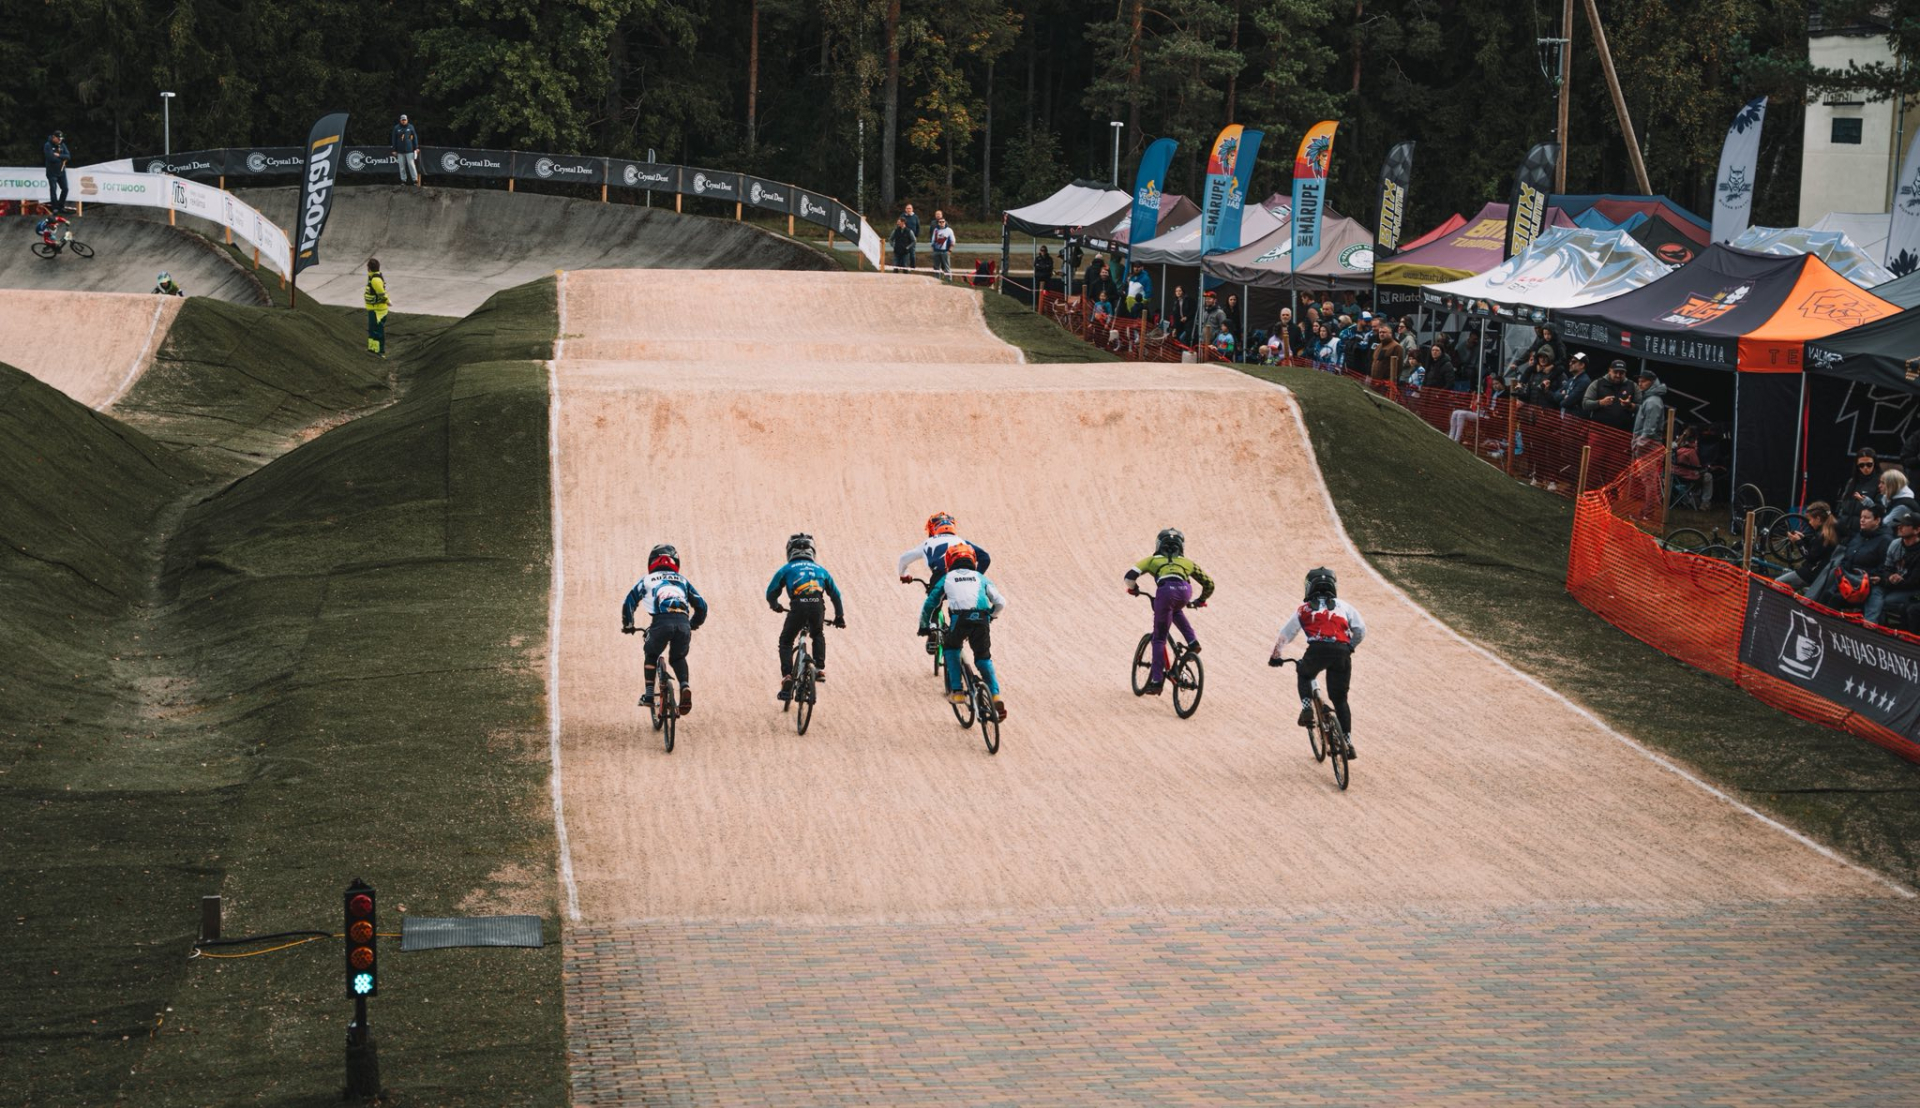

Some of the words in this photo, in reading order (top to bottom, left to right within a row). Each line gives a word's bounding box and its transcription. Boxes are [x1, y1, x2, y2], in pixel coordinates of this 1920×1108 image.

[167, 163, 192, 173] Crystal
[192, 161, 211, 169] Dent
[267, 157, 291, 167] Crystal
[365, 156, 389, 167] Crystal
[459, 158, 483, 168] Crystal
[484, 159, 500, 168] Dent
[553, 164, 576, 174] Crystal
[577, 166, 593, 174] Dent
[637, 171, 655, 181] Crystal
[656, 173, 669, 182] Dent
[103, 183, 146, 193] SOFTWOOD
[1207, 179, 1227, 226] MĀRUPE
[1297, 183, 1319, 235] MĀRUPE
[1378, 178, 1397, 249] BMX
[1510, 181, 1537, 256] BMX
[1464, 219, 1507, 240] BM
[1297, 235, 1314, 248] BMX
[1564, 319, 1590, 340] BMX
[1645, 335, 1677, 356] TEAM
[1681, 340, 1725, 363] LATVIA
[1829, 631, 1878, 667] KAFIJAS
[1877, 647, 1919, 684] BANKA
